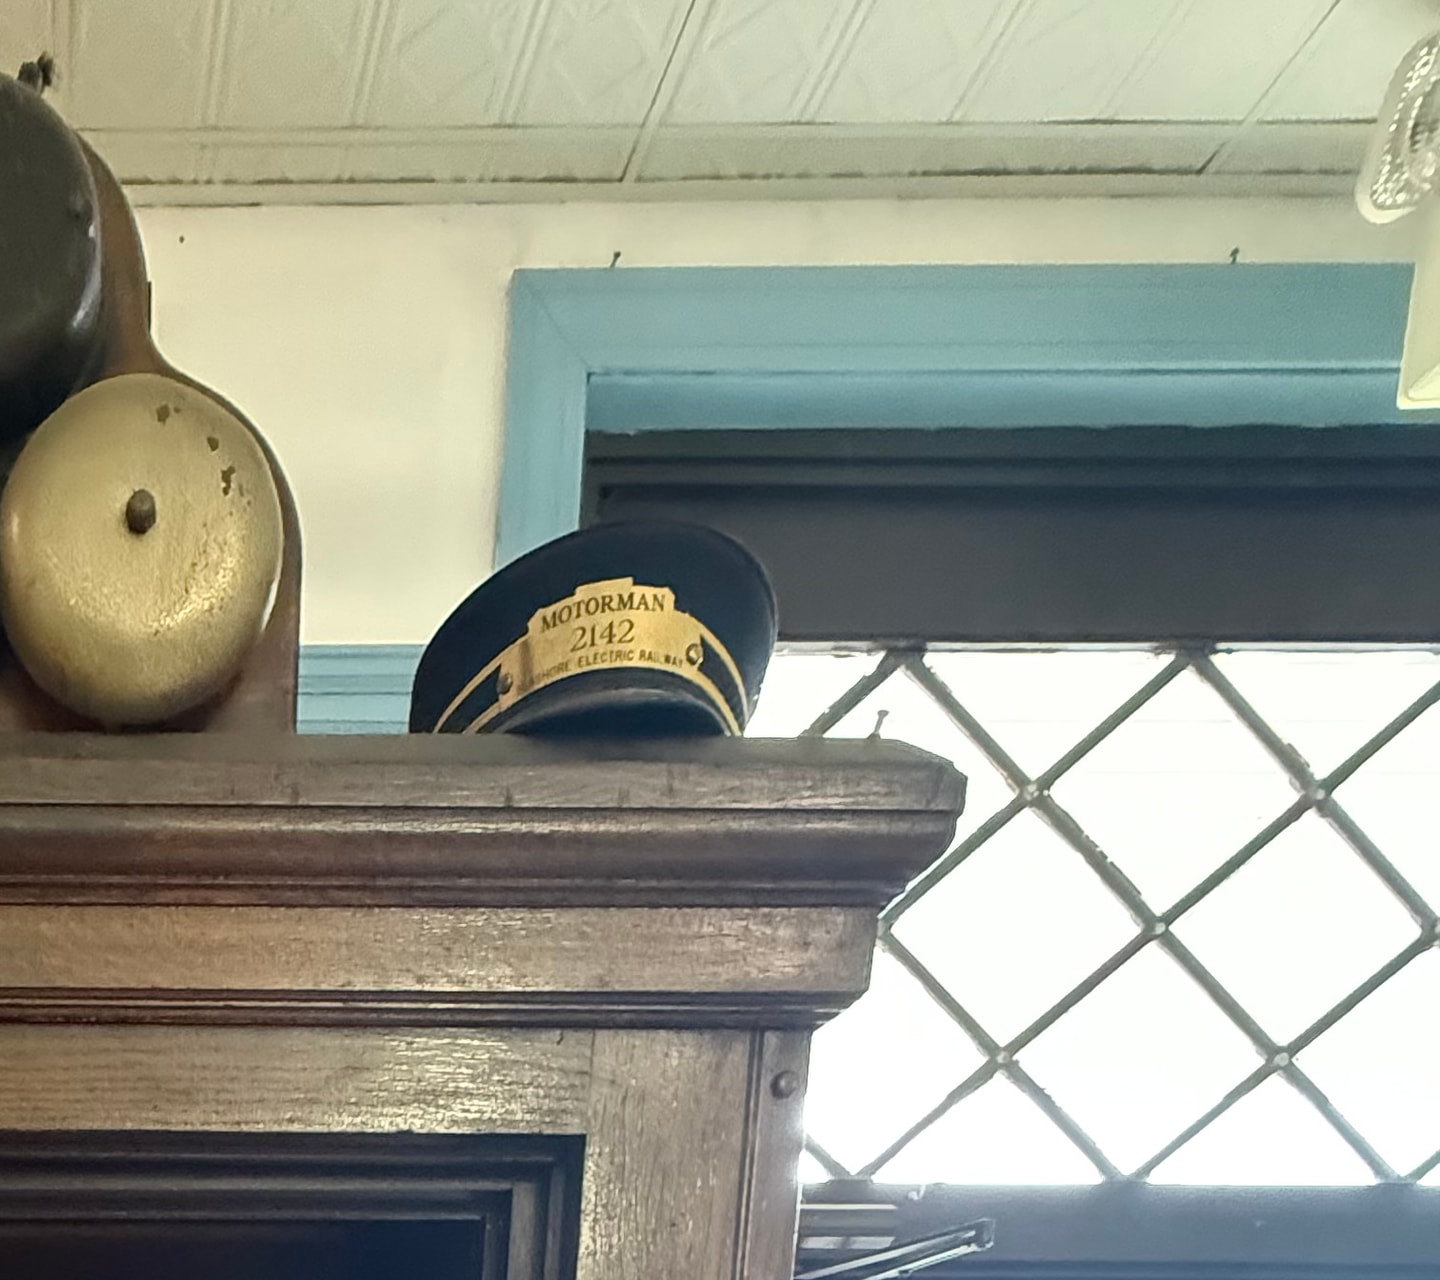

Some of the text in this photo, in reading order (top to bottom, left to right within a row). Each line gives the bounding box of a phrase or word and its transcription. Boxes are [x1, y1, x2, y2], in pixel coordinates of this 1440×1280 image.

[540, 593, 666, 633] MOTORMAN
[570, 618, 635, 651] 2142
[578, 649, 635, 668] ELECTRIC
